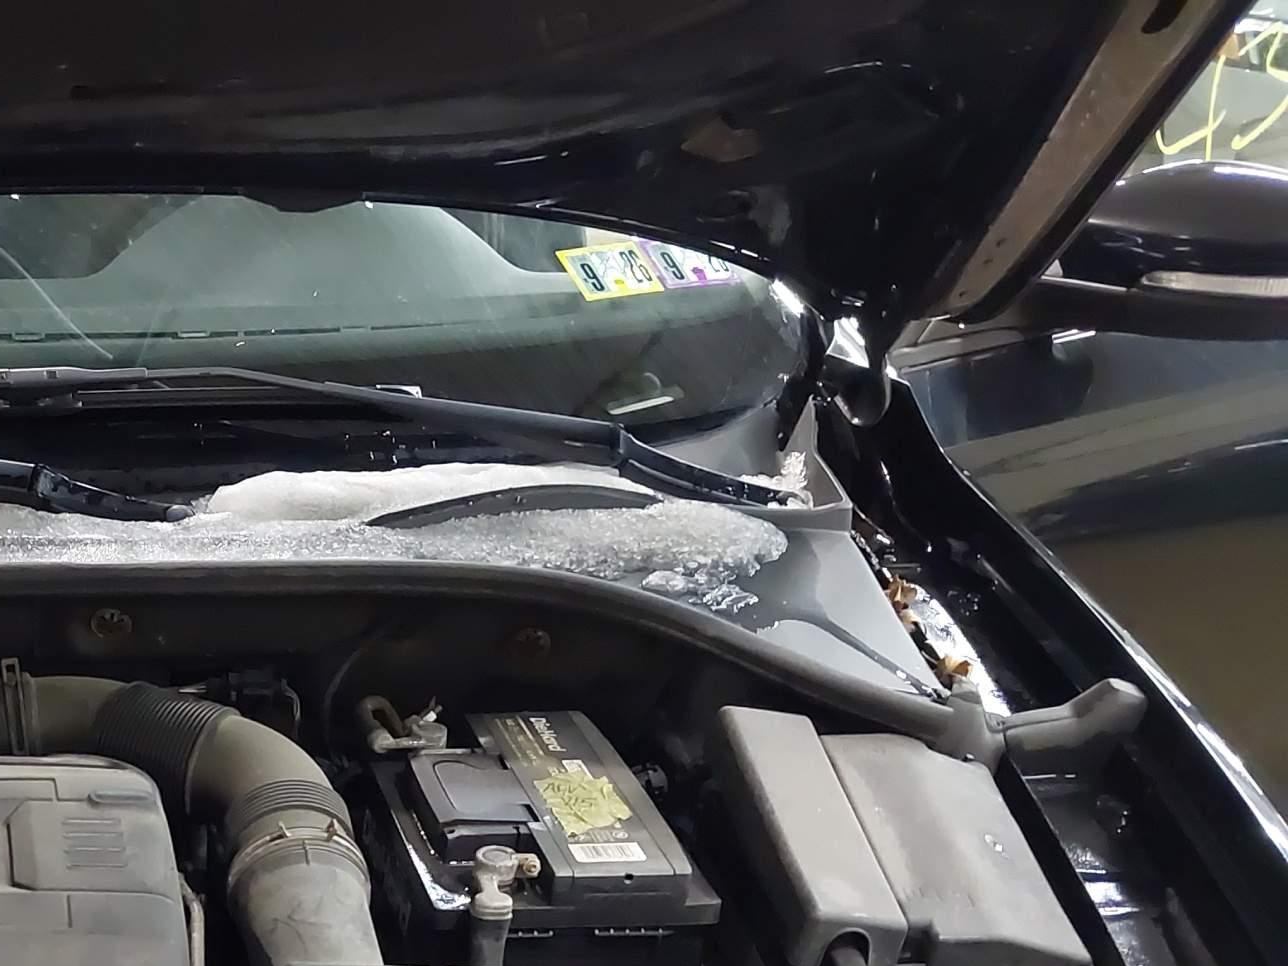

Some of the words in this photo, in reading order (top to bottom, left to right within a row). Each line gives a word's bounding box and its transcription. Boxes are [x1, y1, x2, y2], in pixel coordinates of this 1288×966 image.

[579, 262, 605, 292] 9
[662, 251, 686, 282] 9
[528, 717, 567, 752] DieHard
